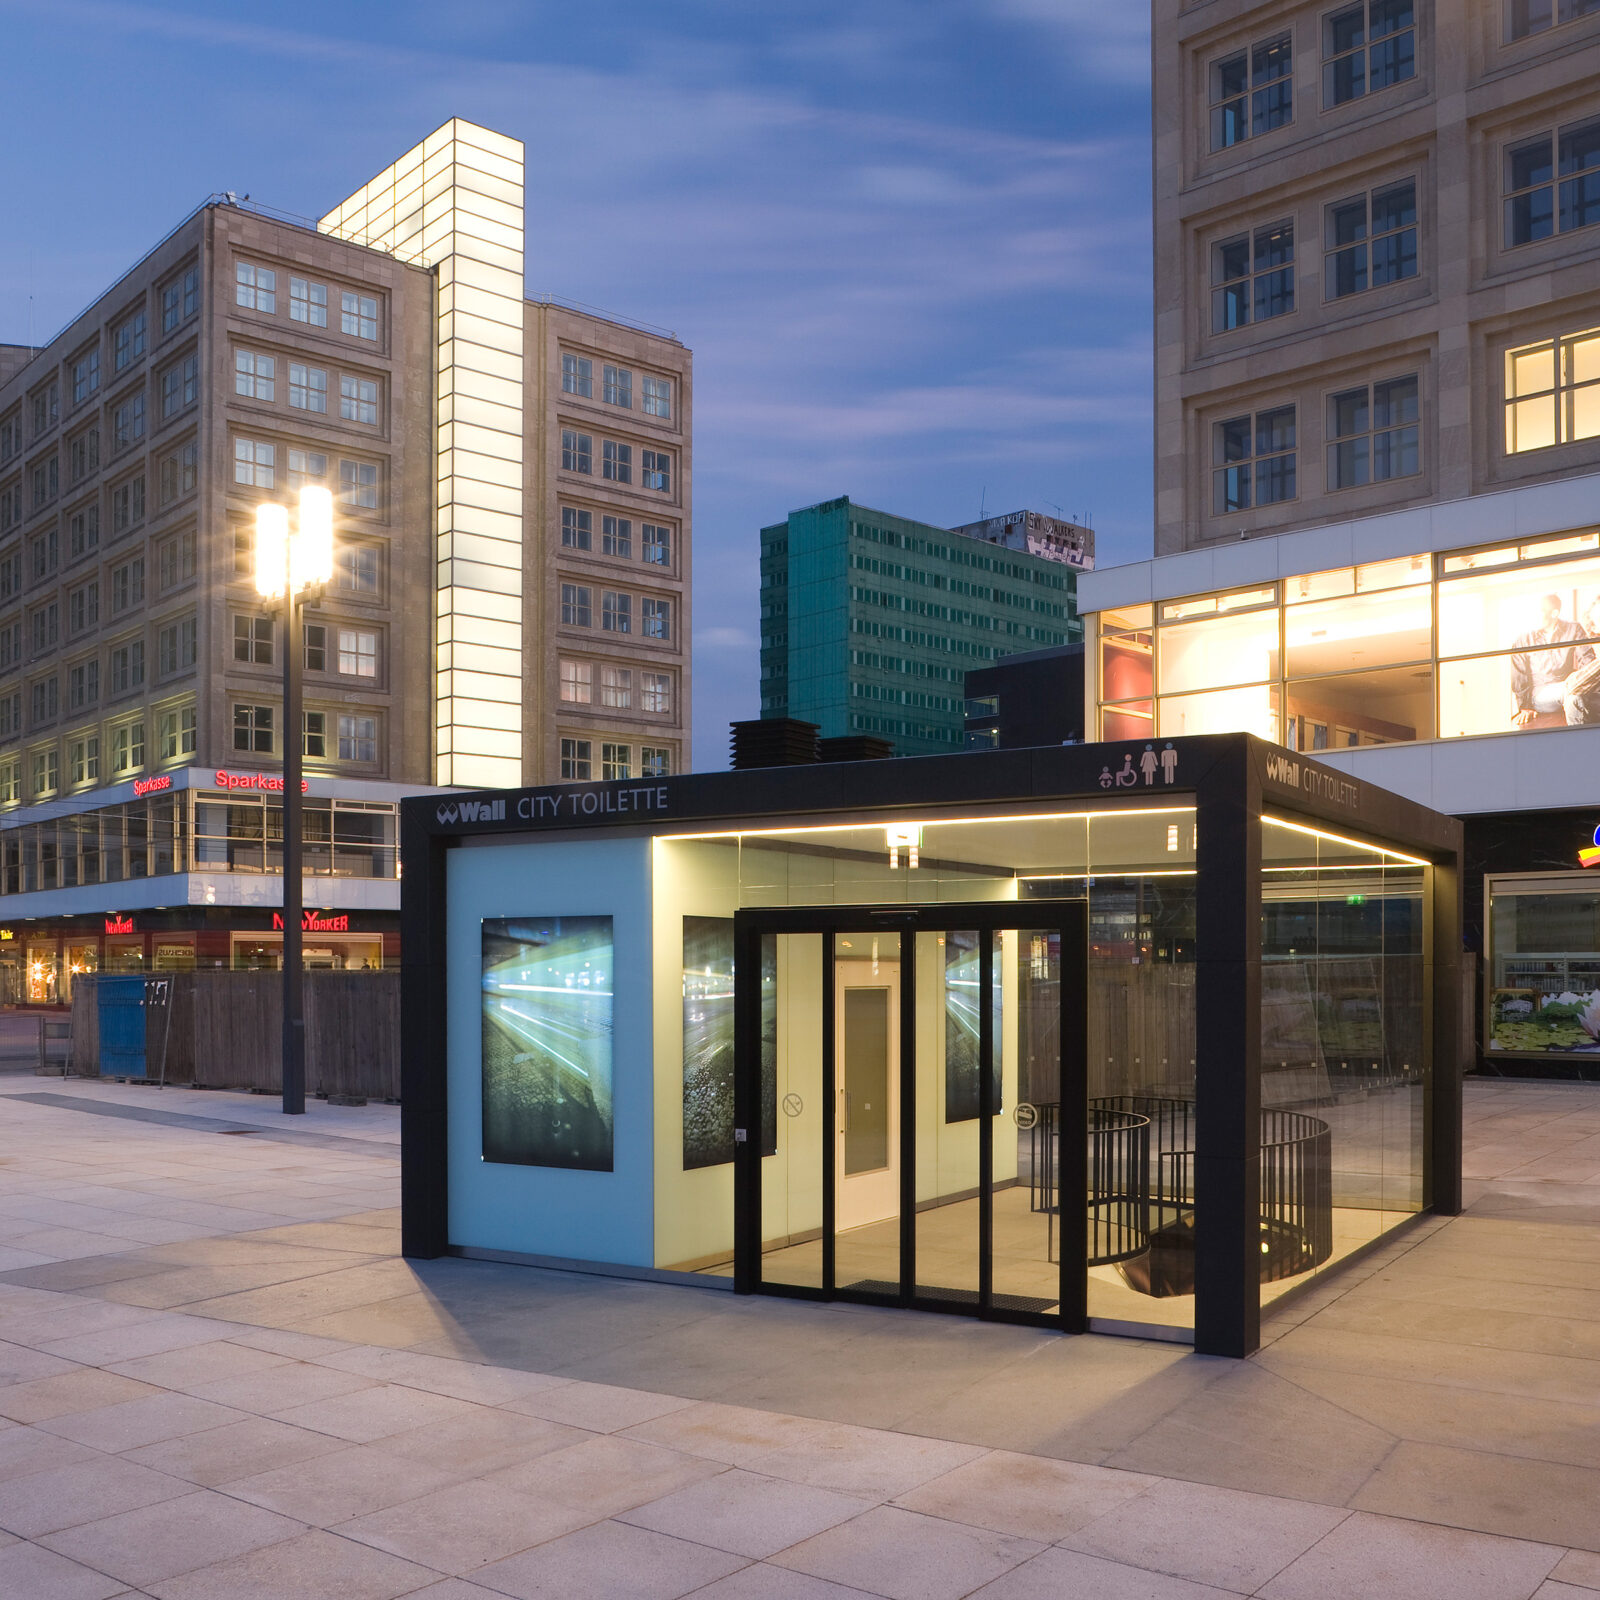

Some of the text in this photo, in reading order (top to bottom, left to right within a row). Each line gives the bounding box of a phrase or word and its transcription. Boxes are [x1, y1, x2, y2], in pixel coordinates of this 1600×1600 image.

[134, 776, 171, 796] Sparkasse
[215, 770, 309, 792] Sparkase
[1277, 756, 1358, 808] Wall CITY TOILETTE
[458, 786, 668, 822] Wall CITY TOILETTE
